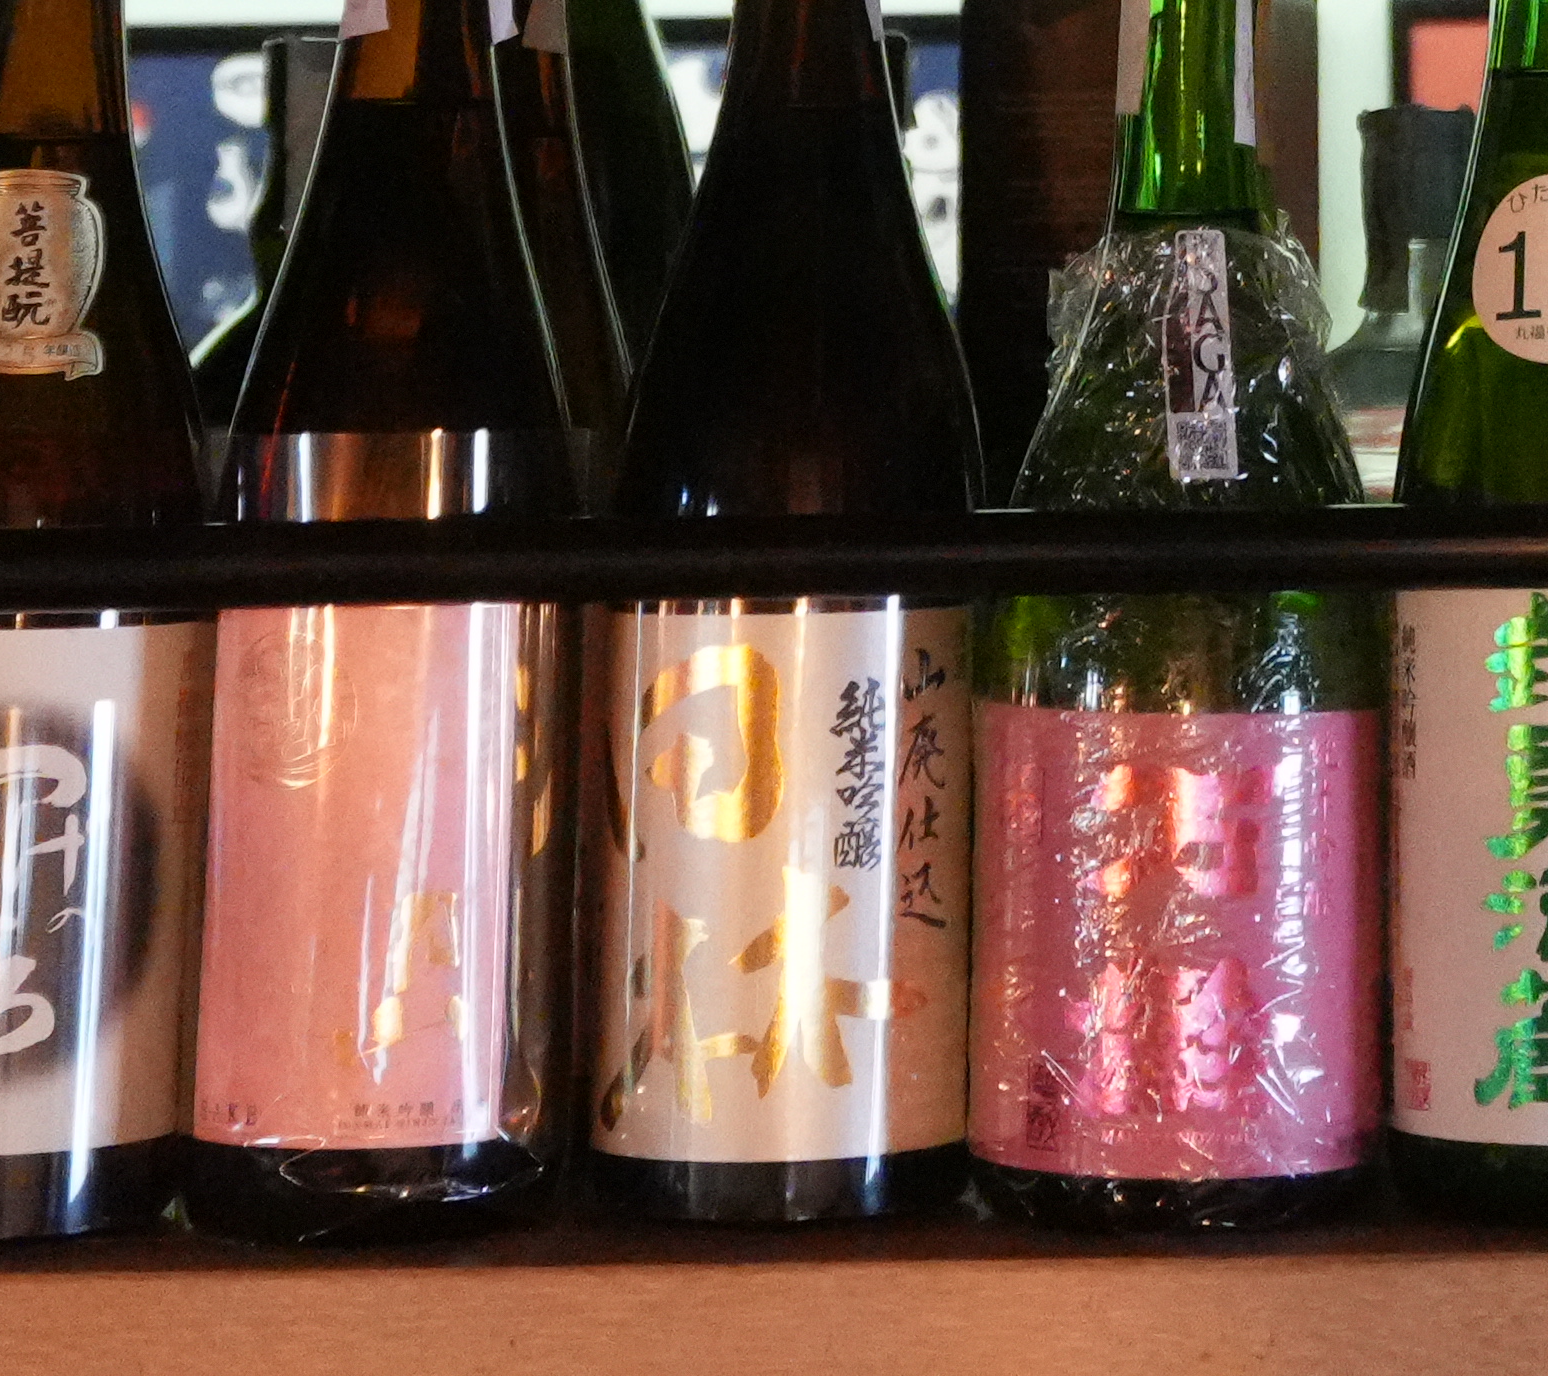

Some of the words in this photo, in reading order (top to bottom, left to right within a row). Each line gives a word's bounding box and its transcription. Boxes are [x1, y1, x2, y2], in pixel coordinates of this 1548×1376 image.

[831, 678, 888, 871] 純米吟醸
[897, 647, 950, 929] 山廃仕込
